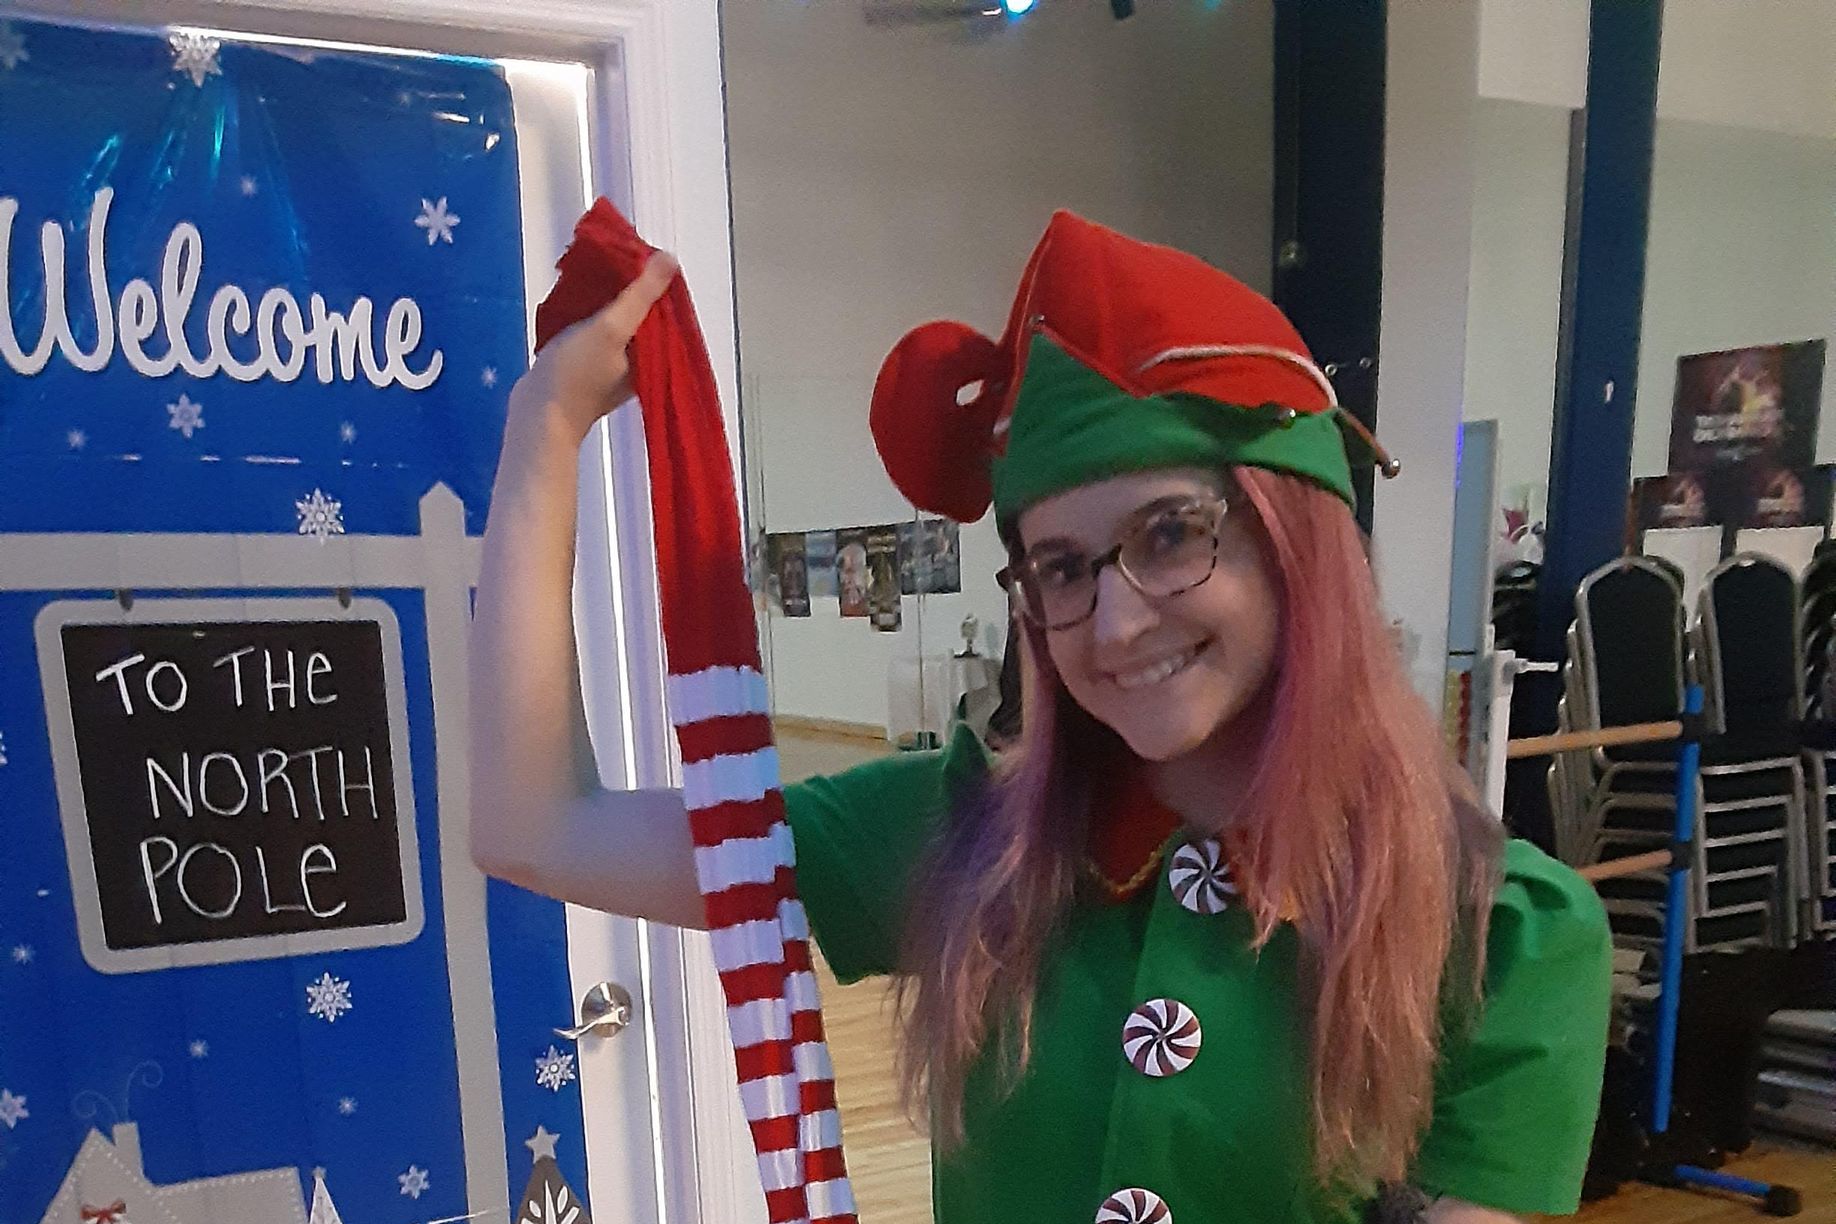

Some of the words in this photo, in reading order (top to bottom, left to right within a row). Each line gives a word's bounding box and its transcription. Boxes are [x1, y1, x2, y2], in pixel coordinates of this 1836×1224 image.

[0, 186, 444, 391] Welcome
[96, 653, 188, 716] TO
[145, 745, 380, 820] NORTH
